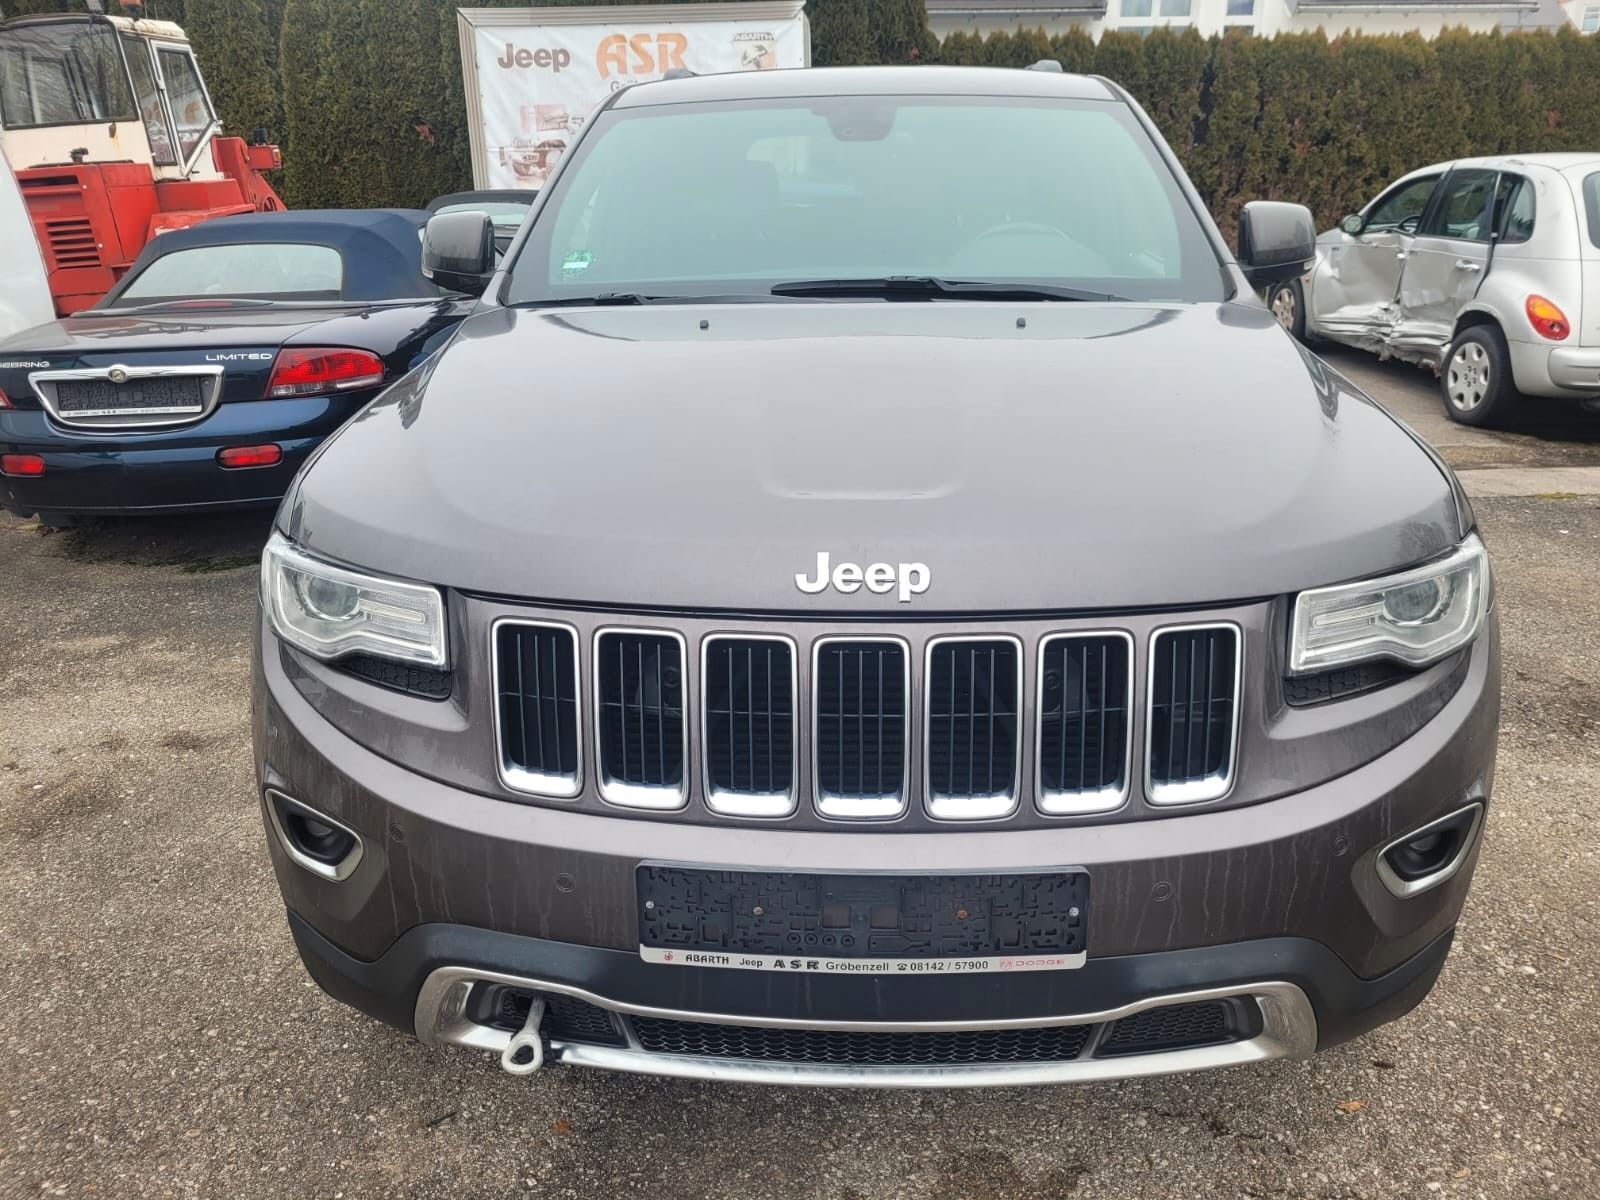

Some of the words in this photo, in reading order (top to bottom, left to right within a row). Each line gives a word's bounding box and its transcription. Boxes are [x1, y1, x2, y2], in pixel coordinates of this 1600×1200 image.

[498, 43, 571, 73] Jeep
[596, 33, 688, 80] ASR
[205, 352, 273, 361] LIMITED
[794, 551, 932, 603] Jeep
[685, 954, 729, 965] ABARTH
[739, 957, 764, 968] Jeep
[825, 961, 889, 971] Gröbenzell
[910, 962, 945, 971] 08142
[955, 961, 989, 970] 57900
